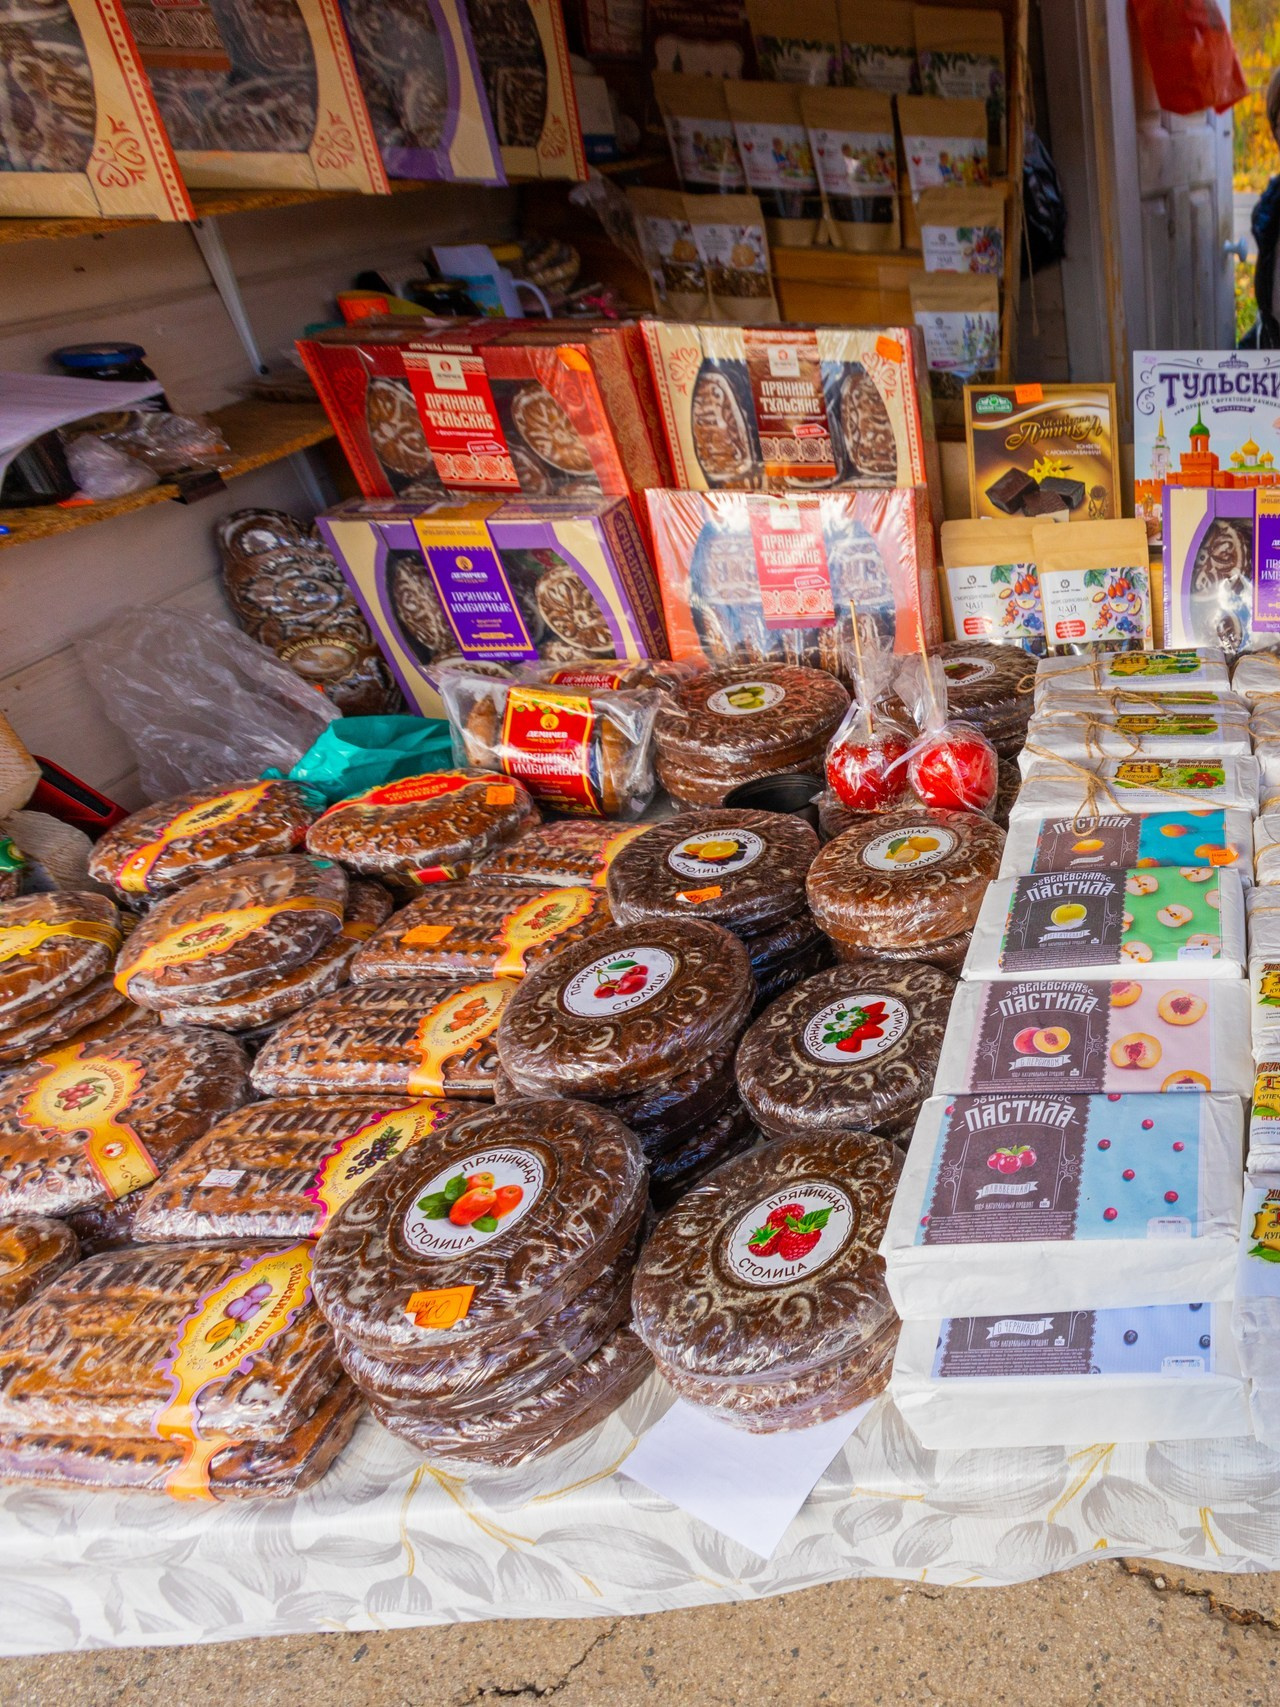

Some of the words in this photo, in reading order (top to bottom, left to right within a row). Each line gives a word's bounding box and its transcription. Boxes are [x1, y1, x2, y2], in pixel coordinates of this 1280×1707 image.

[761, 380, 815, 396] ПРЯНИКИ
[424, 392, 486, 411] ПРЯНИКИ
[759, 397, 821, 414] ТУЛЬСКИЕ
[425, 410, 496, 430] ТУЛЬСКИЕ
[761, 534, 815, 548] ПРЯНИКИ
[760, 550, 821, 566] ТУЛЬСКИЕ
[450, 591, 503, 602] ПРЯНИКИ
[450, 601, 512, 614] ИМБИРНЫЕ
[1057, 602, 1077, 614] ЧАЙ
[1051, 814, 1133, 835] ПАСТИЛА
[696, 828, 757, 846] ПРЯНИЧНАЯ
[869, 827, 931, 852] ПРЯНИЧНАЯ
[675, 861, 729, 876] СТОЛИЦА
[893, 849, 945, 871] СТОЛИЦА
[1043, 871, 1102, 884] БЕЛЁВСКАЯ
[1026, 881, 1116, 902] ПАСТИЛА
[569, 949, 636, 997] ПРЯНИЧНАЯ
[610, 970, 669, 1012] СТОЛИЦА
[998, 993, 1099, 1017] ПАСТИЛА
[815, 1001, 846, 1053] ПРЯНИЧНАЯ
[876, 1006, 903, 1049] СТОЛИЦА
[964, 1102, 1076, 1132] ПАСТИЛА
[461, 1150, 537, 1185] ПРЯНИЧНАЯ
[766, 1187, 847, 1214] ПРЯНИЧНАЯ
[411, 1222, 476, 1251] СТОЛИЦА
[737, 1258, 808, 1280] СТОЛИЦА
[266, 1262, 304, 1319] ТУЛЬСКИЙ
[212, 1320, 273, 1370] ПРЯНИК
